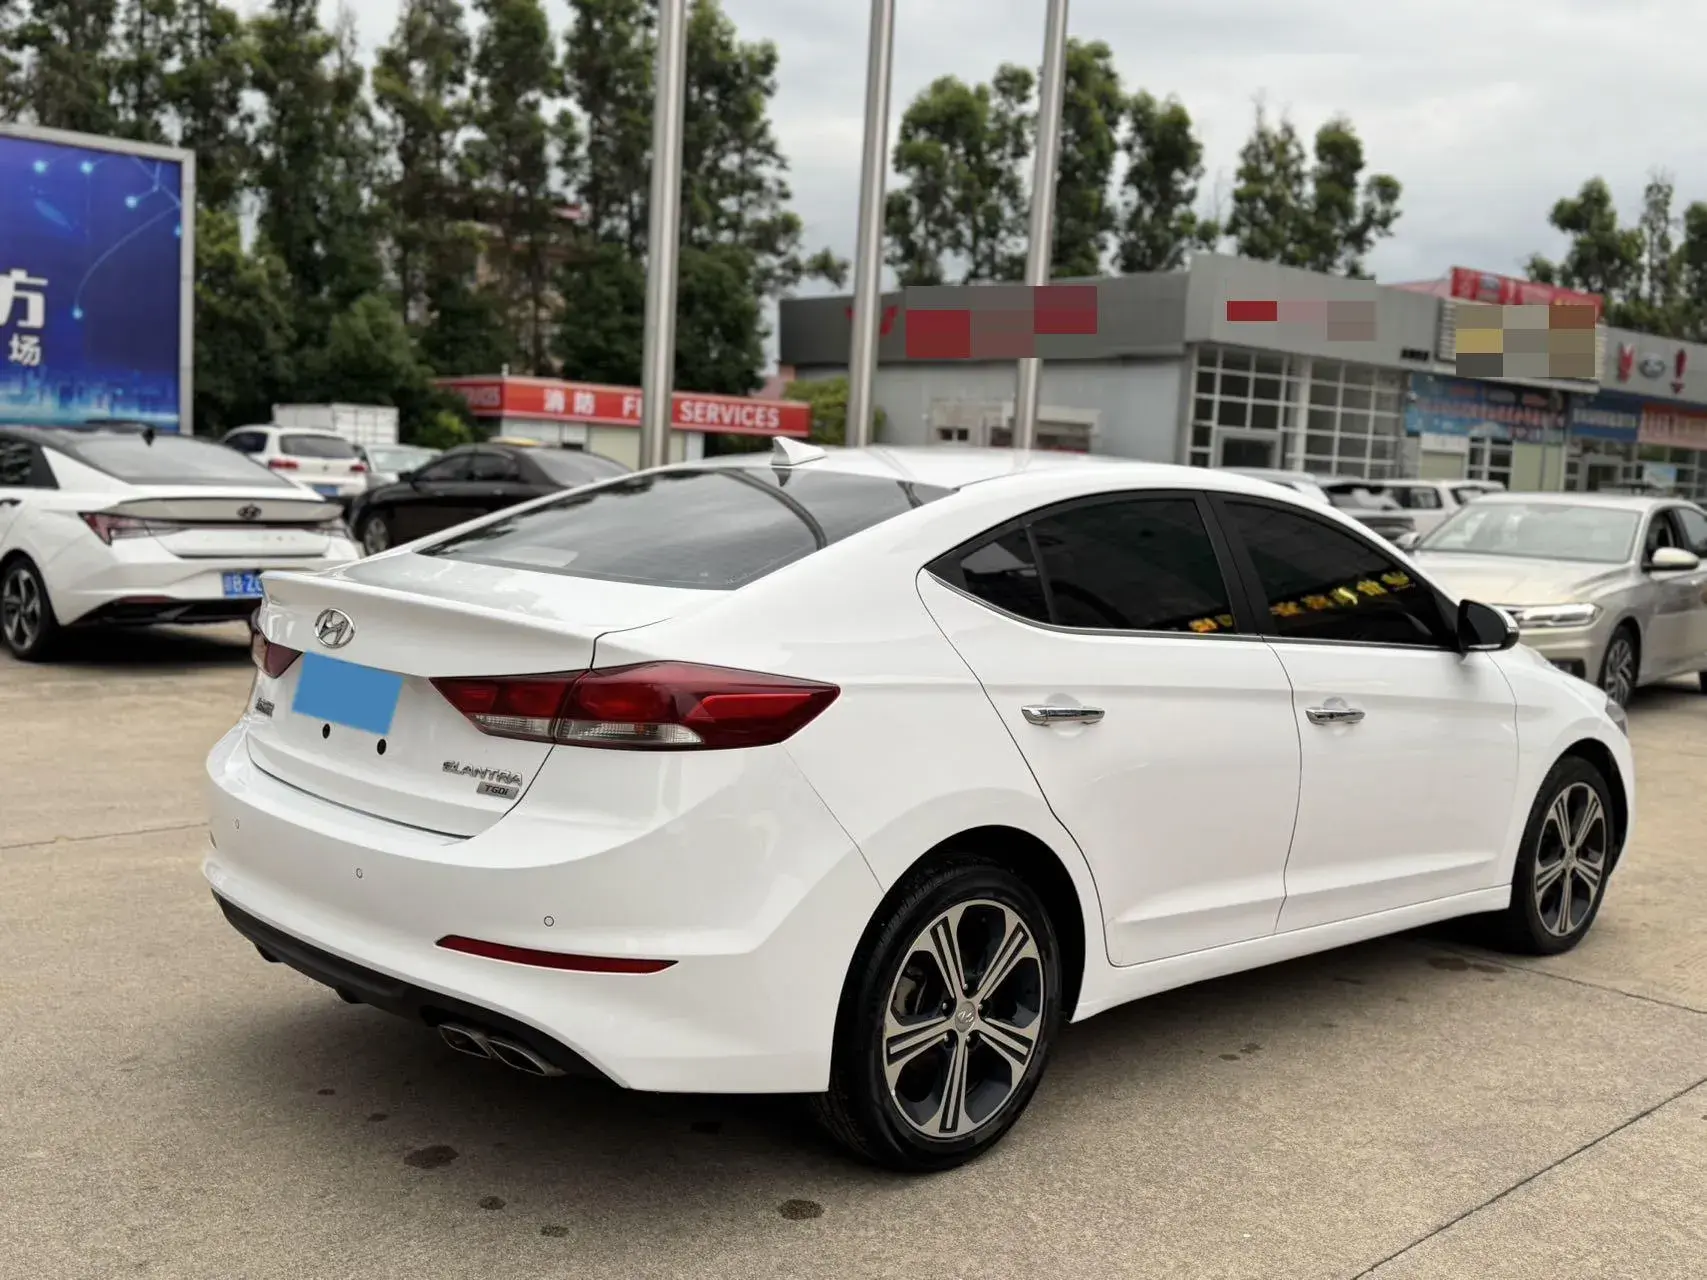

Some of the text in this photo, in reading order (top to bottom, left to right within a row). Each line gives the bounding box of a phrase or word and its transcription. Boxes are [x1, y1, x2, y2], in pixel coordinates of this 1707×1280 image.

[8, 332, 42, 366] 场
[679, 400, 780, 429] SERVICES
[442, 760, 523, 787] ELANTRA
